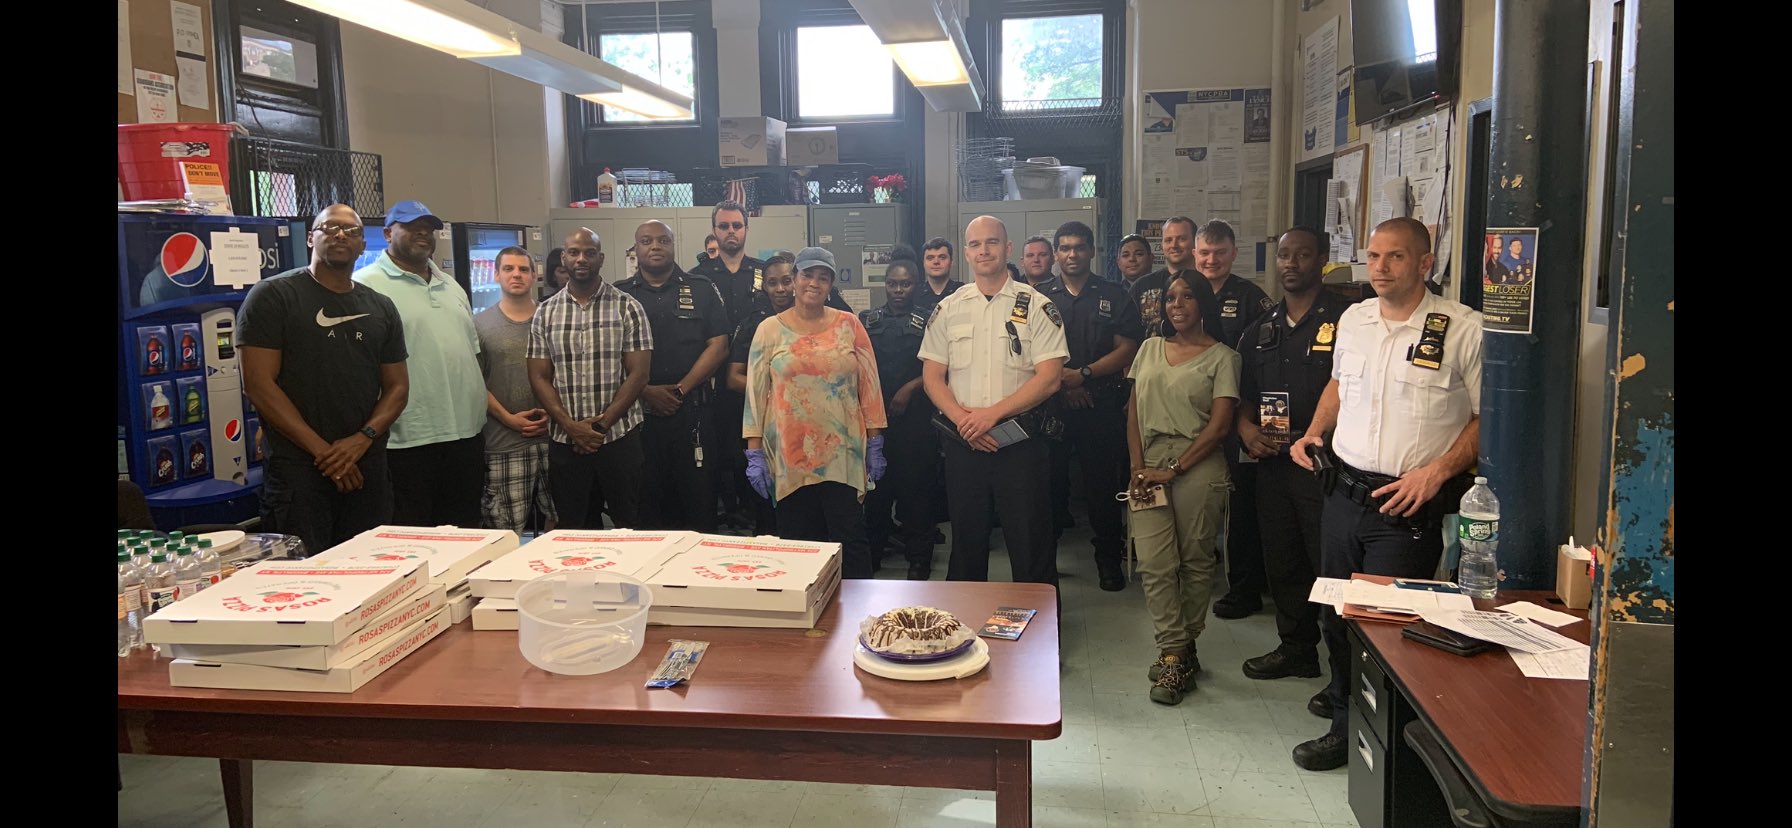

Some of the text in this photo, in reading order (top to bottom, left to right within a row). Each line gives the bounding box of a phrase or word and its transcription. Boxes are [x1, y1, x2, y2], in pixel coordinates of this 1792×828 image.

[327, 329, 362, 341] AIR
[360, 577, 417, 620] ROSASPIZZANYC.COM
[358, 600, 431, 645] ROSASPIZZANYC.COM
[378, 621, 439, 666] ROSASPIZZANYC.COM
